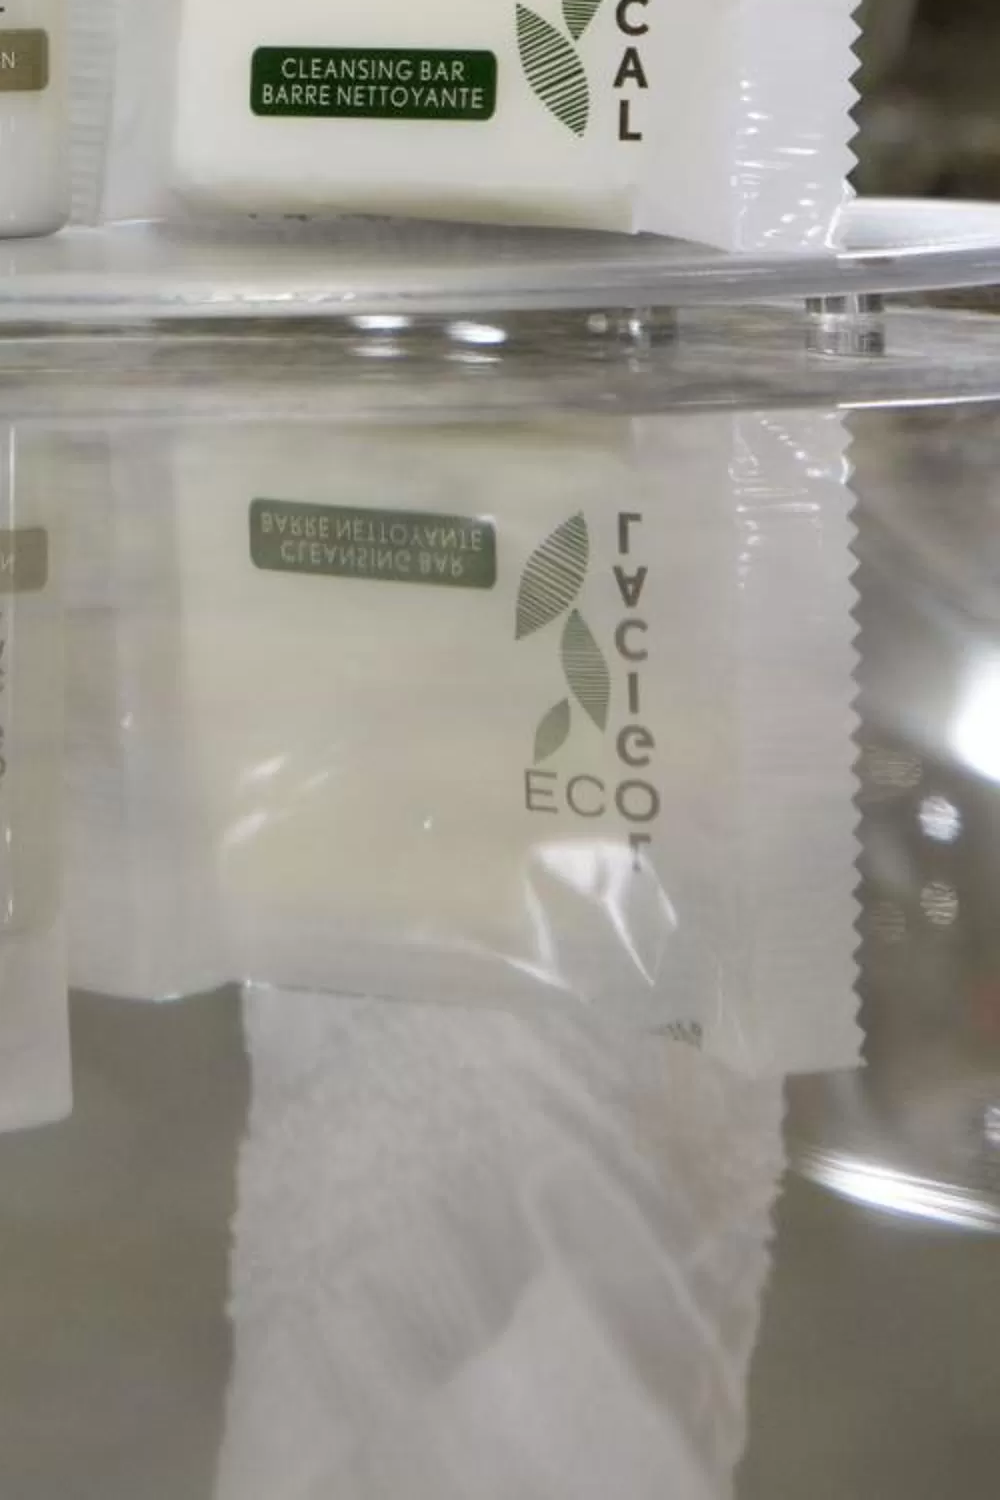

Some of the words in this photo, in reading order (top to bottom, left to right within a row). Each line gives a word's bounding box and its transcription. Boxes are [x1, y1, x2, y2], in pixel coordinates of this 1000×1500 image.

[280, 57, 413, 81] CLEANSING
[419, 60, 465, 82] BAR
[261, 83, 331, 107] BARRE
[335, 84, 484, 110] NETTOYANTE
